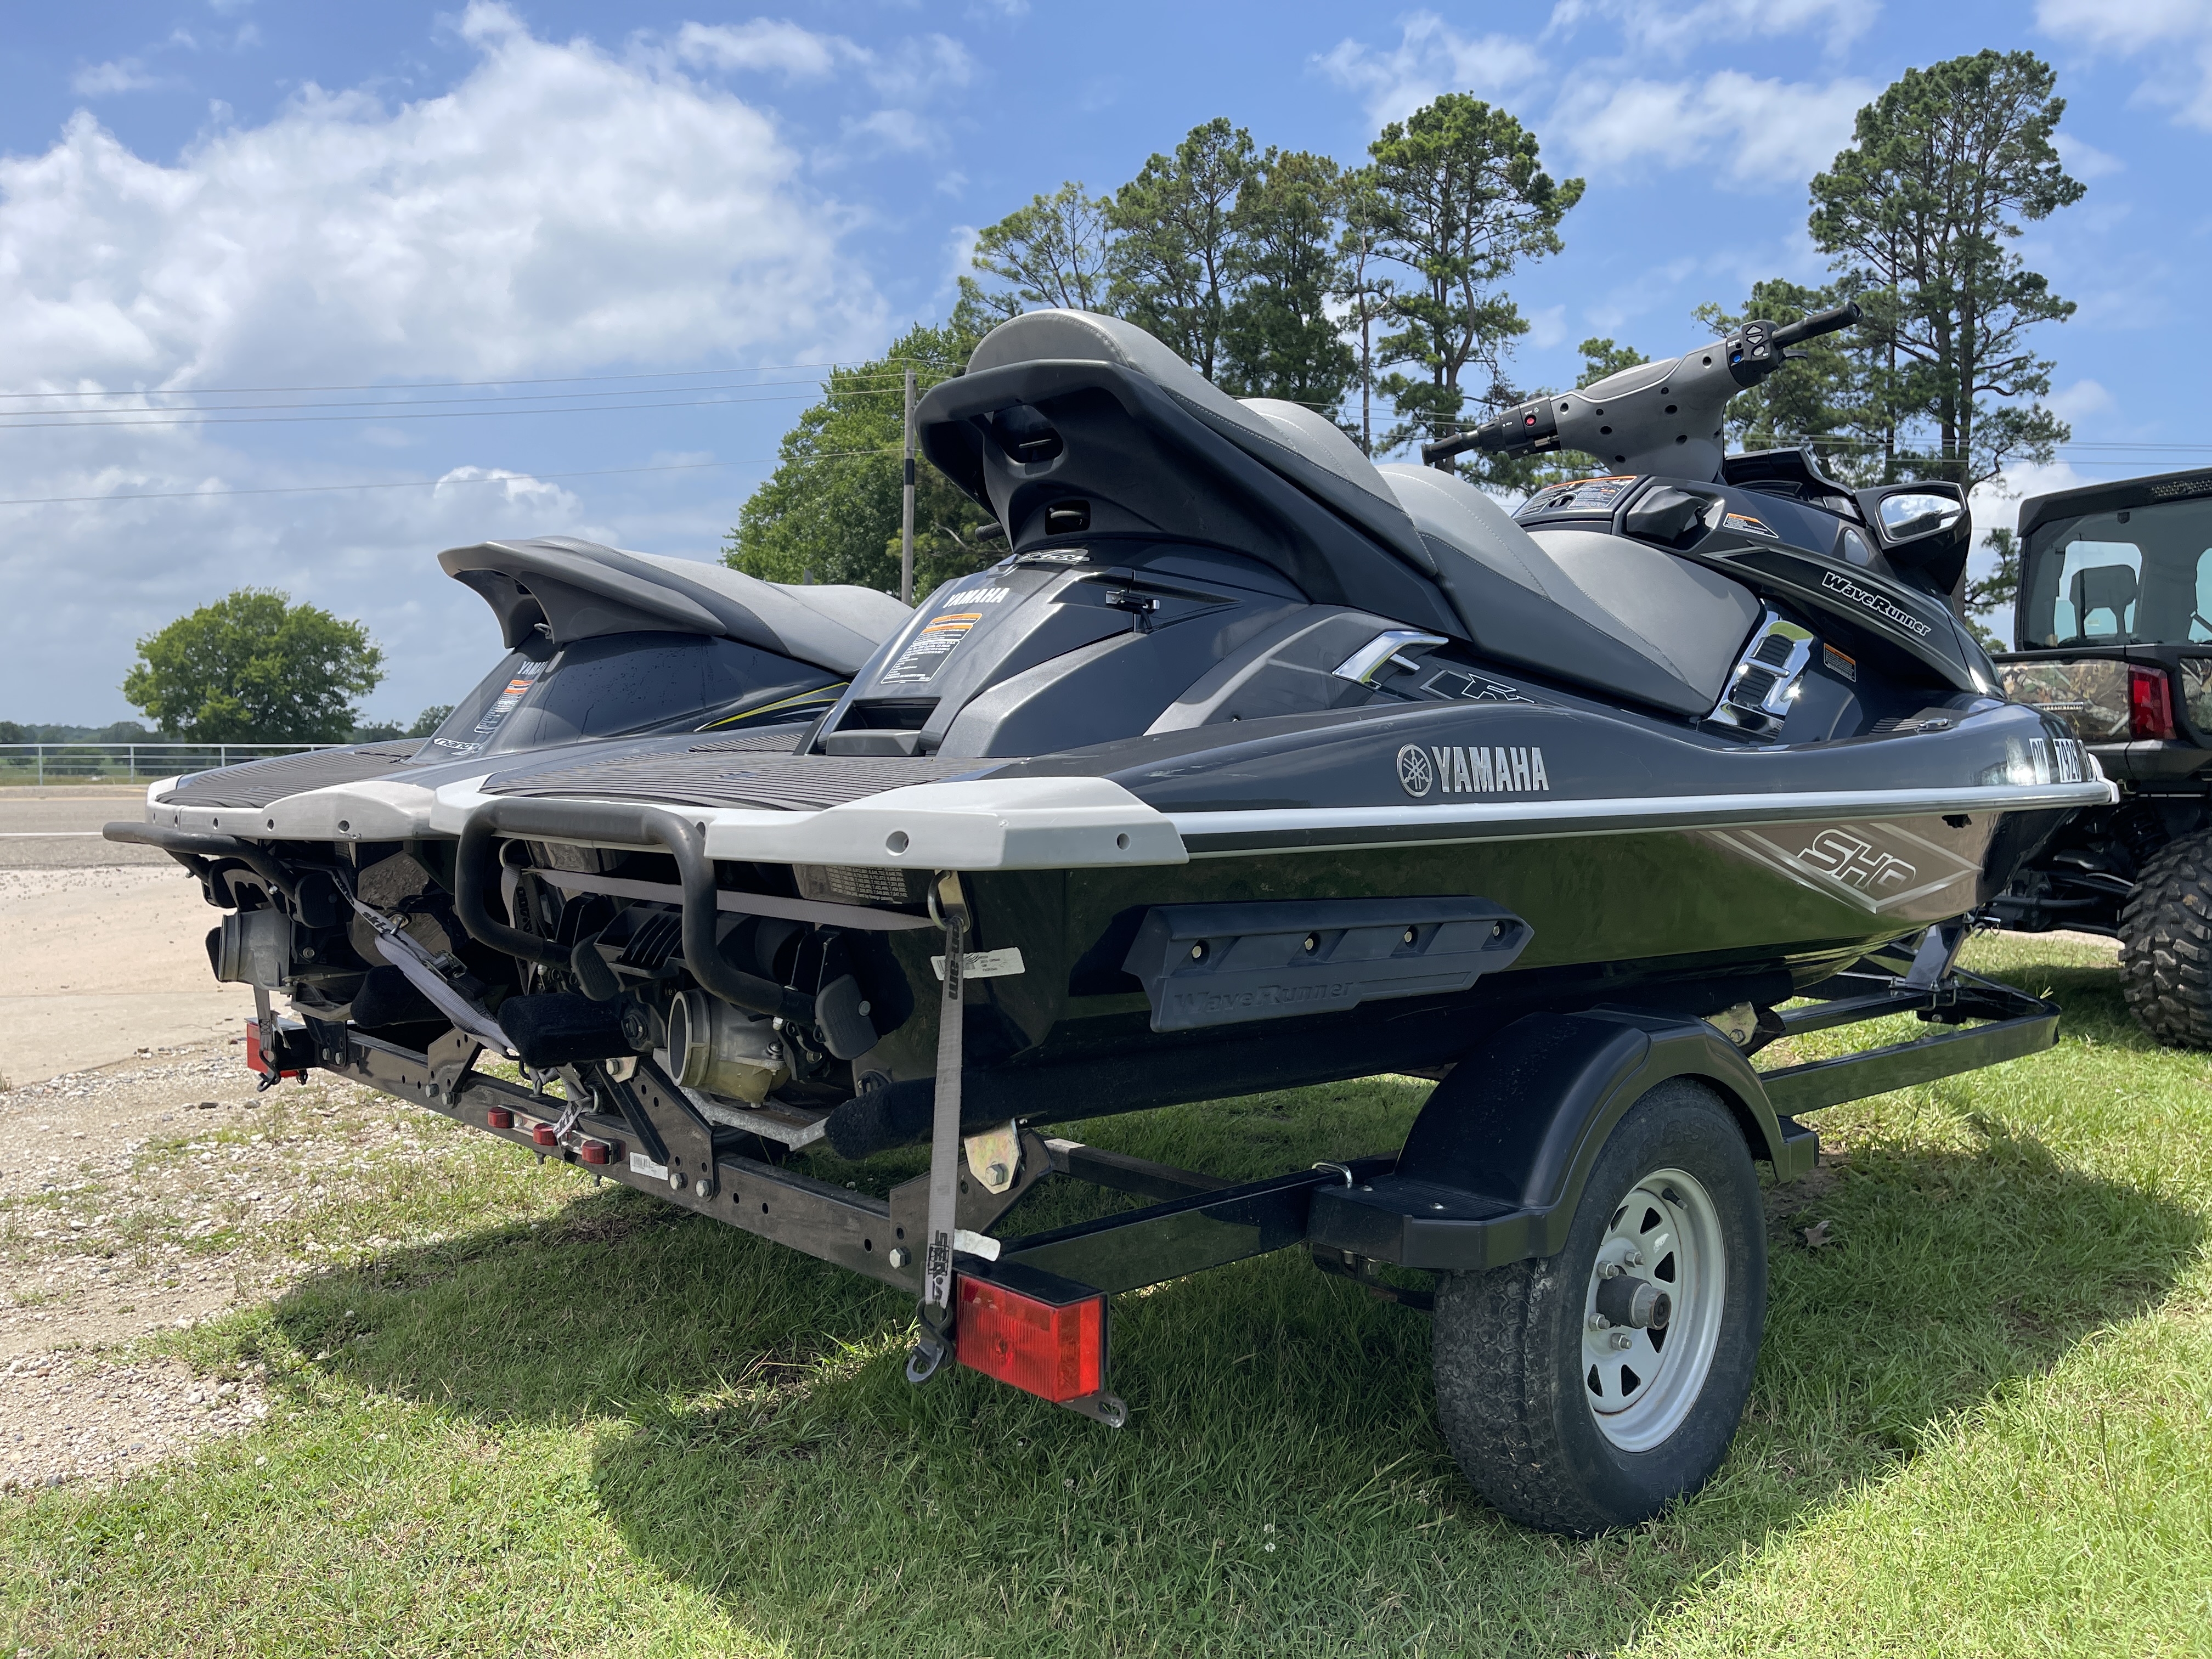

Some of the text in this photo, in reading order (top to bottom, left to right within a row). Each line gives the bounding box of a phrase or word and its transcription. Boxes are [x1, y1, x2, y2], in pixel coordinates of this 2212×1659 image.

[942, 588, 1009, 608] YAMAHA
[1822, 571, 1932, 637] WaveRunner
[1431, 746, 1549, 793] YAMAHA
[2054, 740, 2080, 782] 7926
[1797, 828, 1916, 893] SHO
[949, 925, 960, 1000] an-am
[1173, 980, 1355, 1016] WaveRunner
